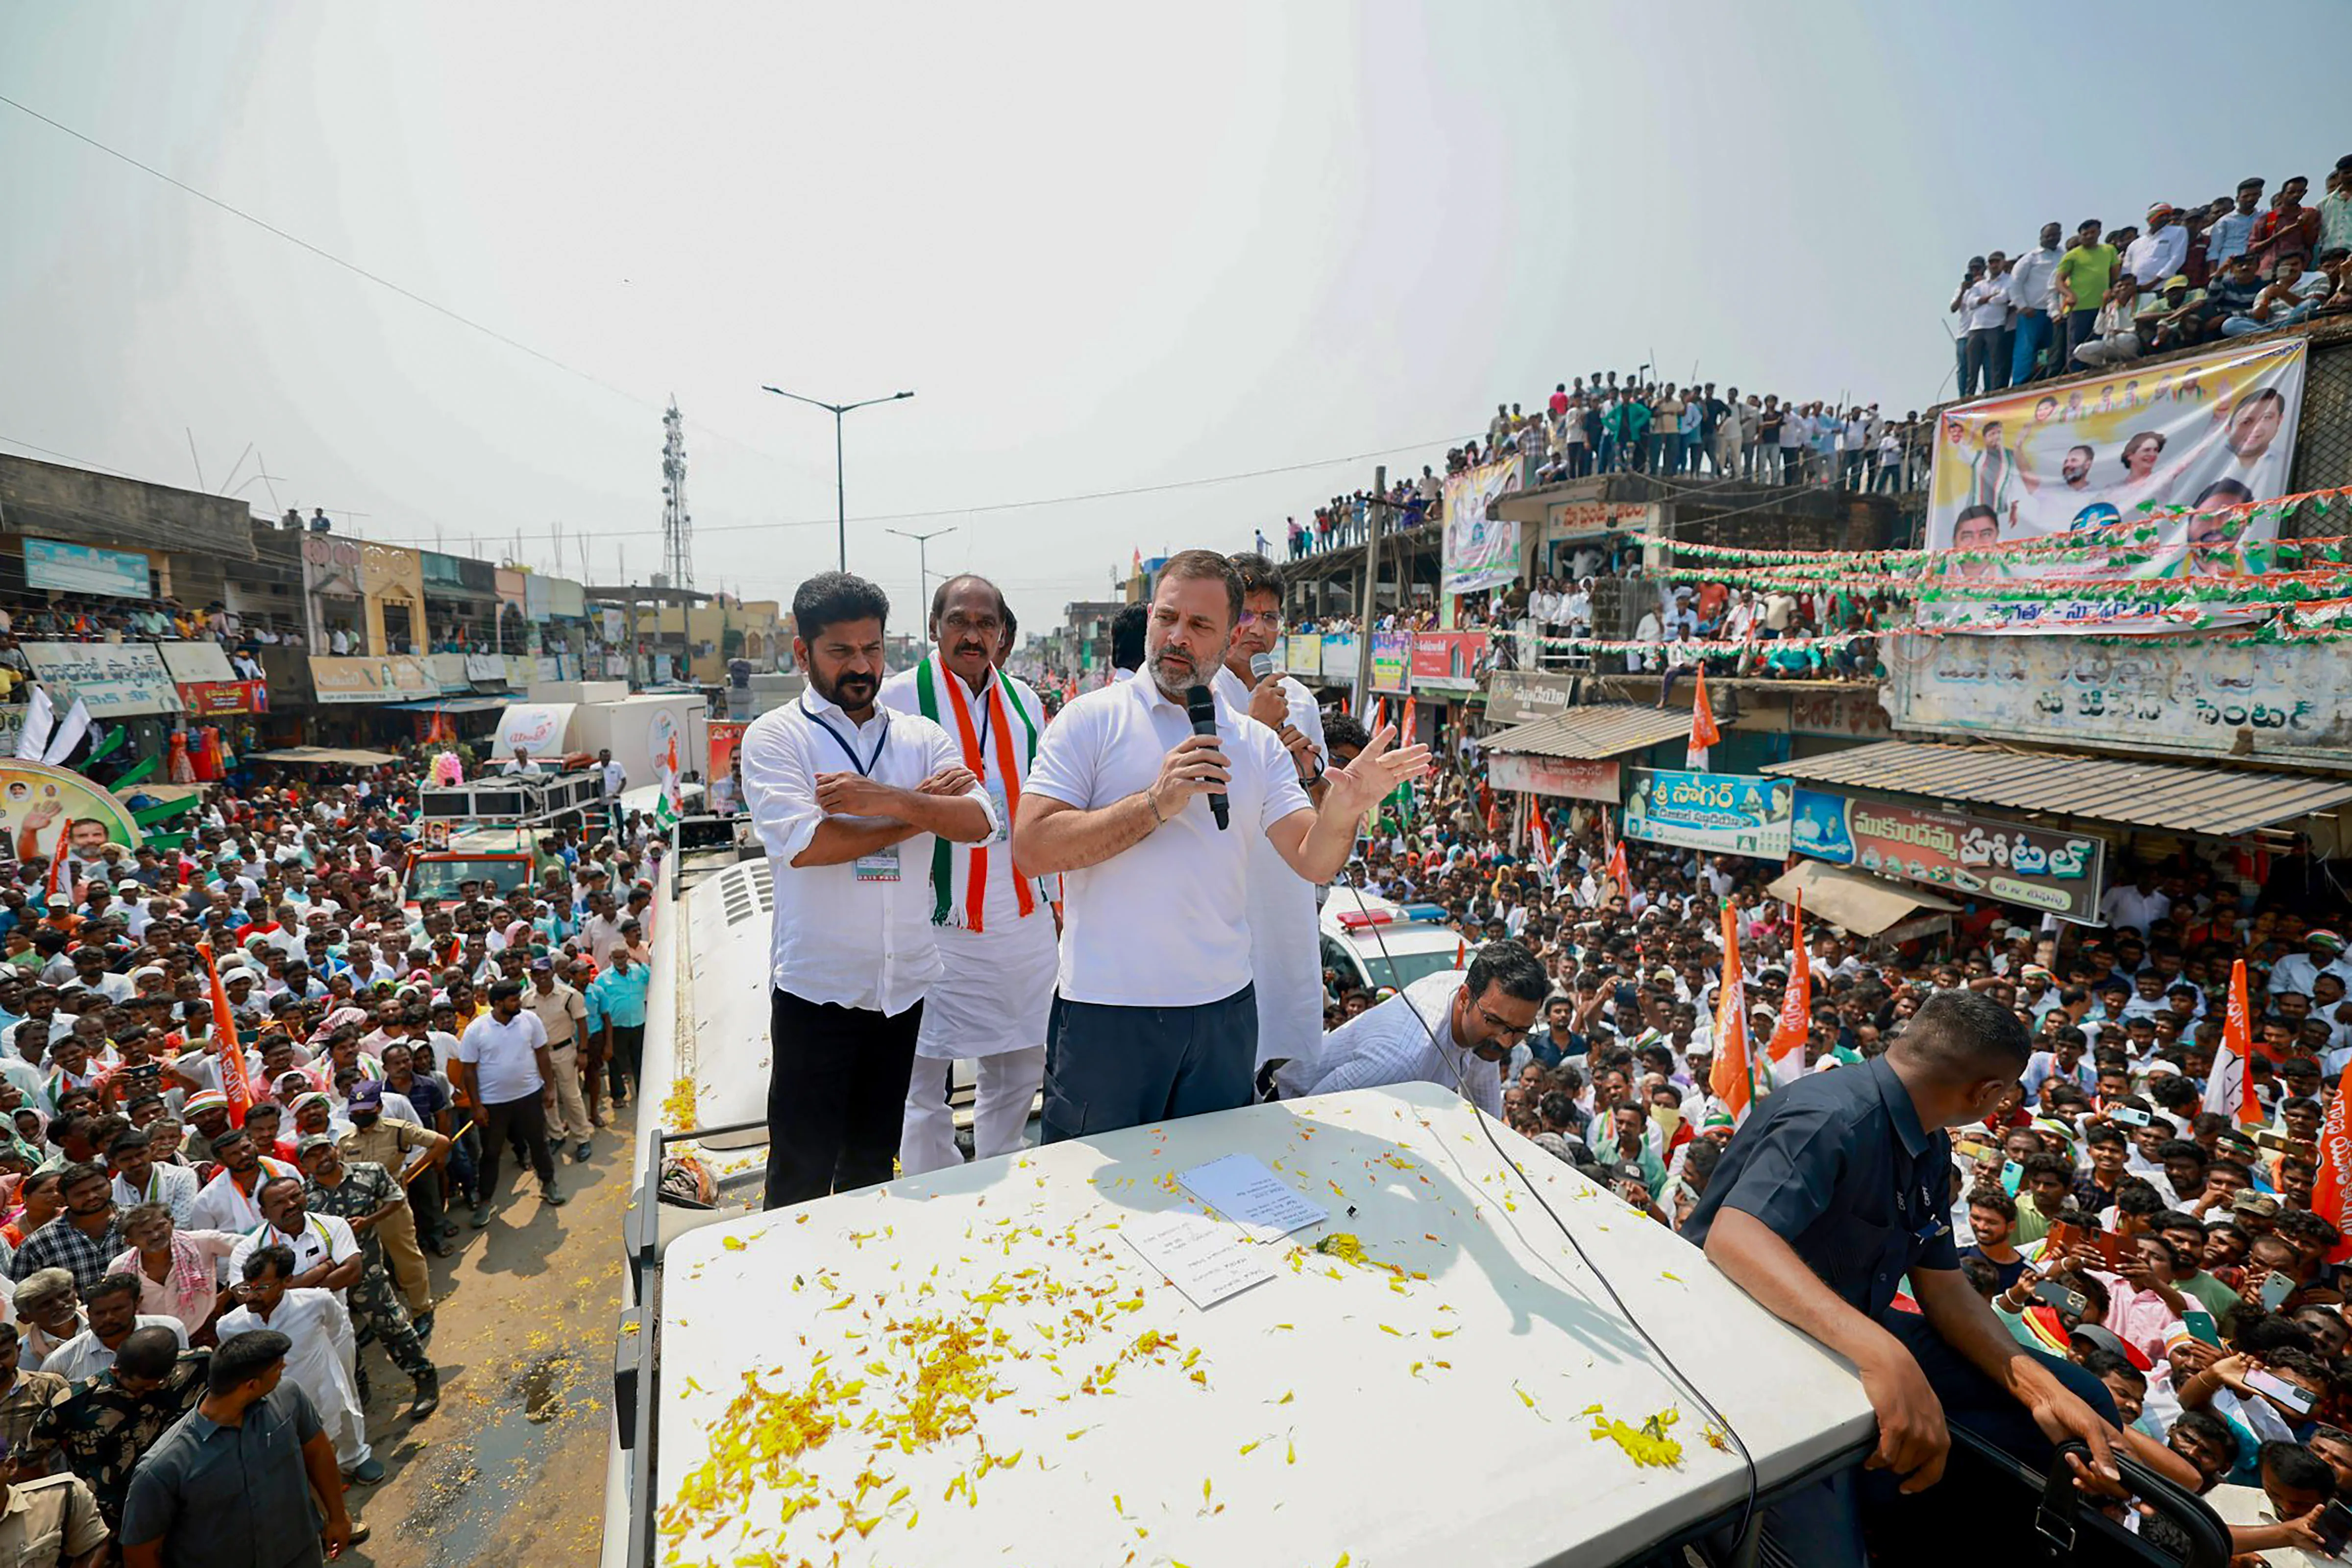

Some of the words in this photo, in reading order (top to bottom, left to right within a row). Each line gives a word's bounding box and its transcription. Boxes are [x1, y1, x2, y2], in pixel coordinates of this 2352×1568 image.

[1672, 782, 1734, 808] సాగర్
[1854, 811, 1958, 861] ముకుందమ్మ
[1960, 827, 2093, 879] హోటల్
[1922, 1185, 1931, 1206] CRPF
